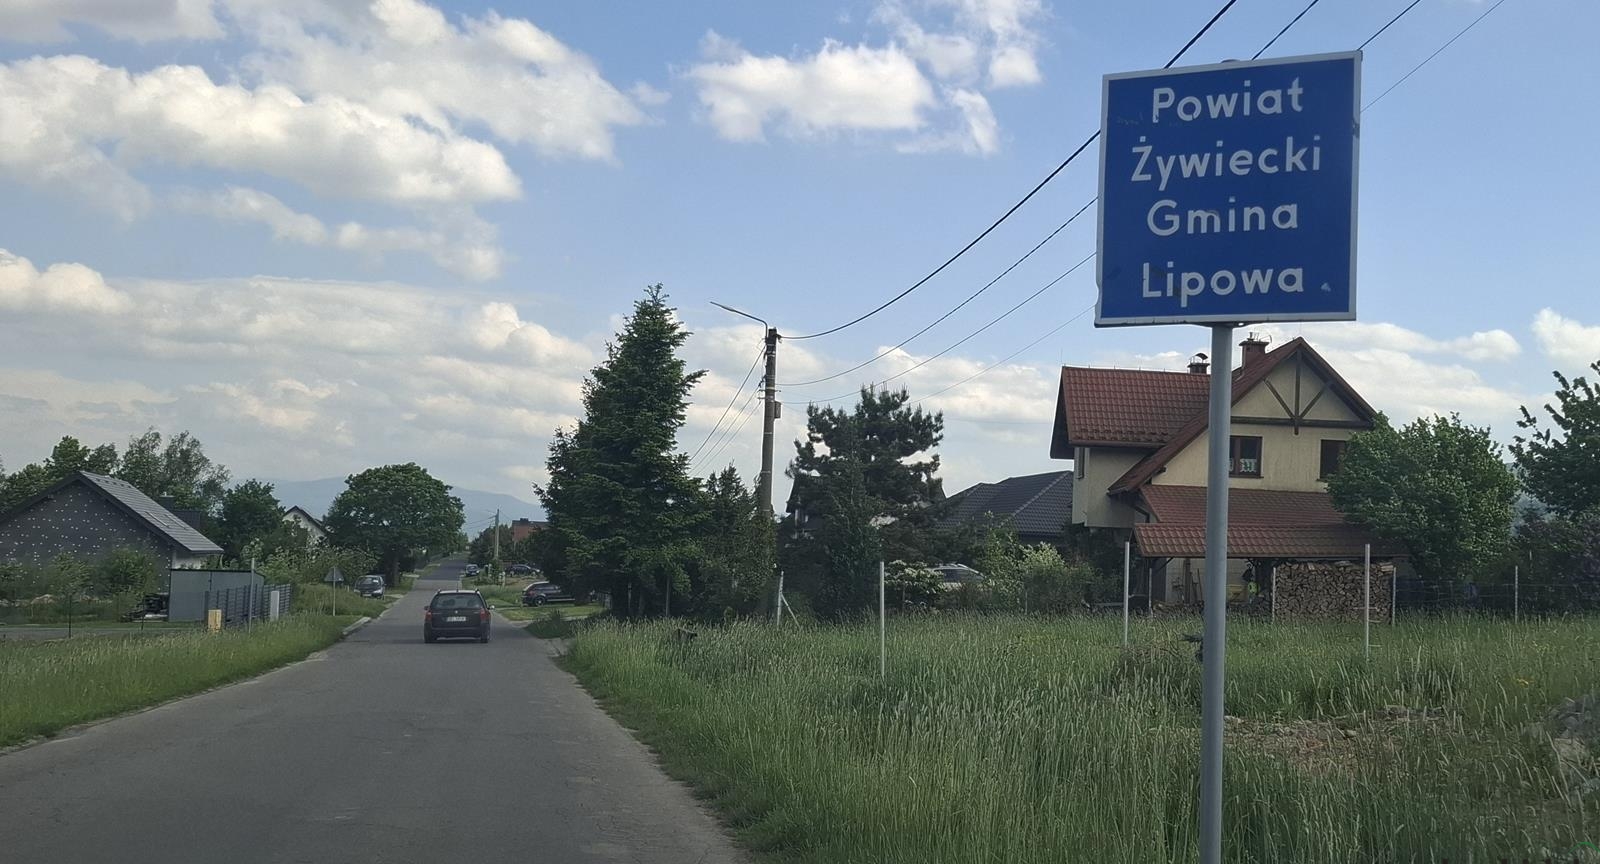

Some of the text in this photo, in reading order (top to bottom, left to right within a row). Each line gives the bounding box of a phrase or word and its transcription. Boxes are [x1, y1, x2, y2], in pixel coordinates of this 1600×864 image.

[1152, 77, 1303, 123] Powiat
[1131, 135, 1321, 191] Żywiecki
[1147, 197, 1298, 236] Gmina
[1142, 262, 1304, 308] Lipowa
